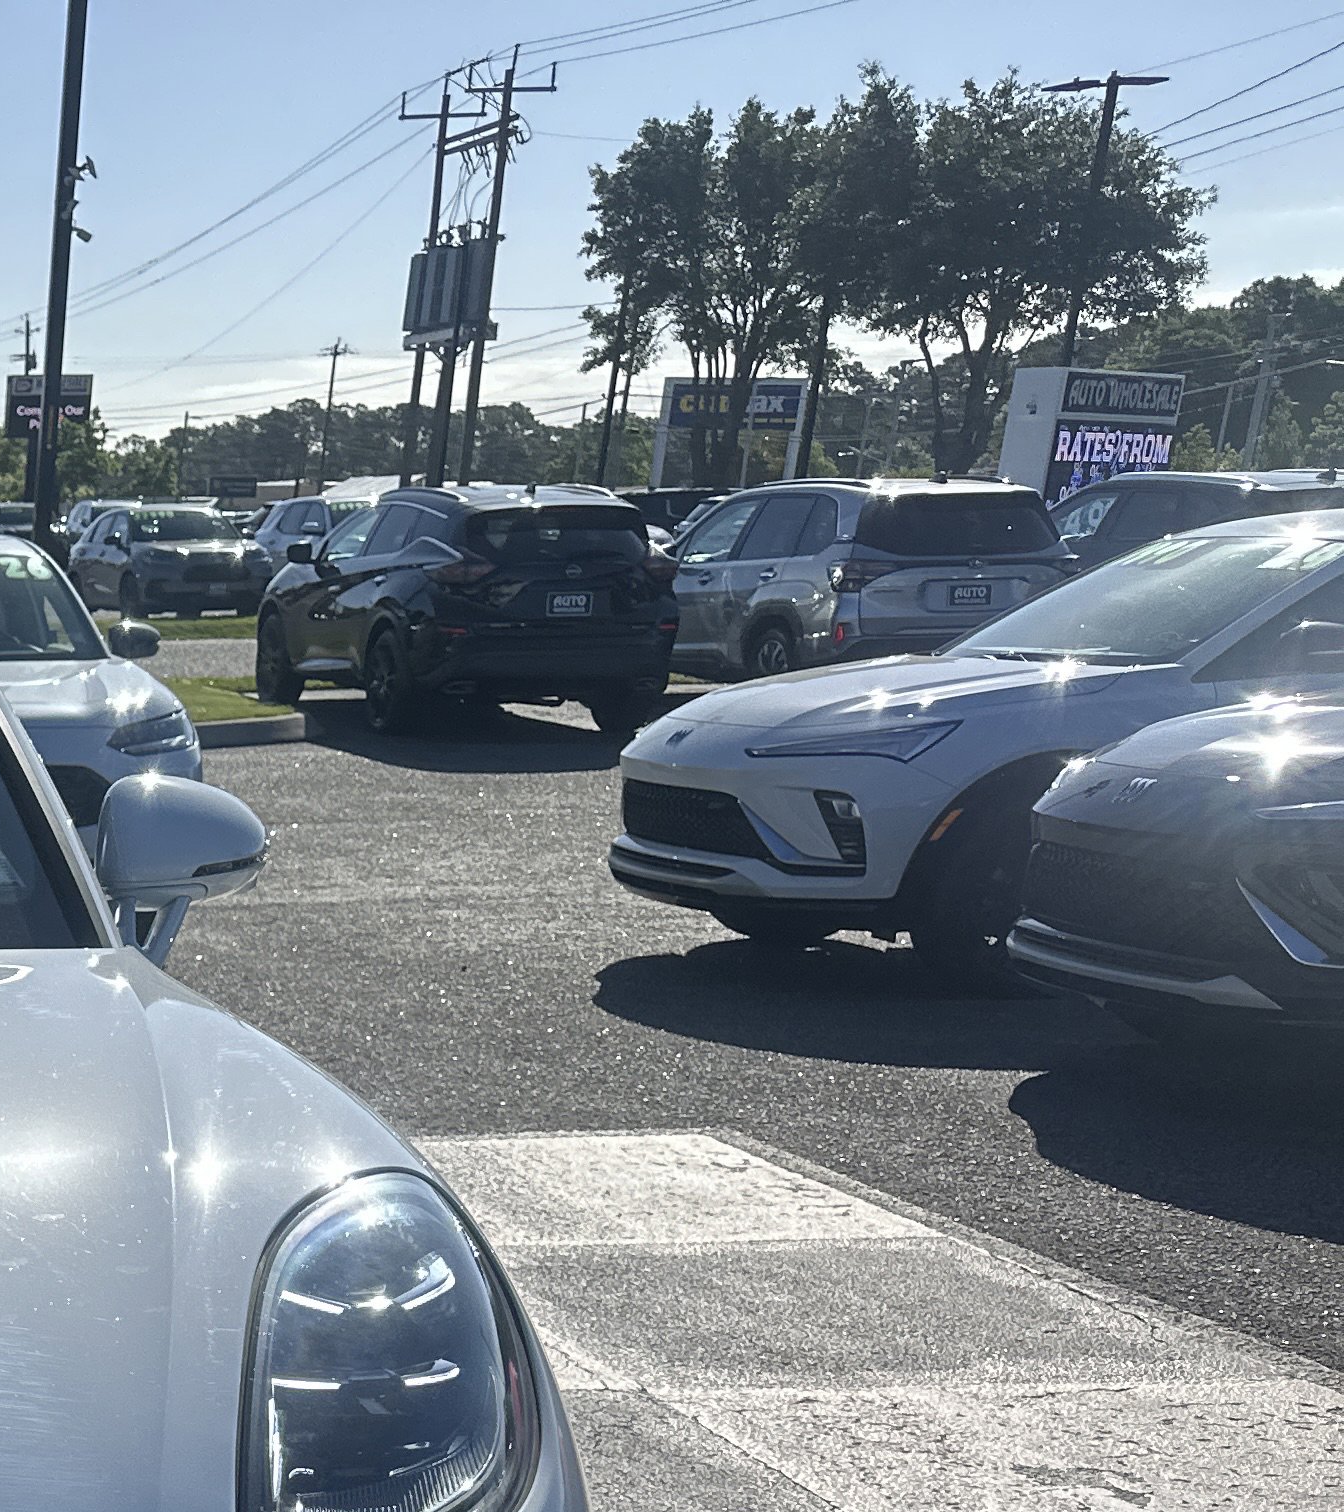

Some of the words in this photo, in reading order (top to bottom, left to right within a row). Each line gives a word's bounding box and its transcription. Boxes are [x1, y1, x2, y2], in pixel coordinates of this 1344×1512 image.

[1068, 378, 1106, 408] AUTO
[1105, 378, 1180, 412] WHOLESALE
[1054, 430, 1116, 463] RATES
[1119, 433, 1173, 464] FROM
[553, 595, 587, 607] AUTO
[953, 586, 987, 599] AUTO
